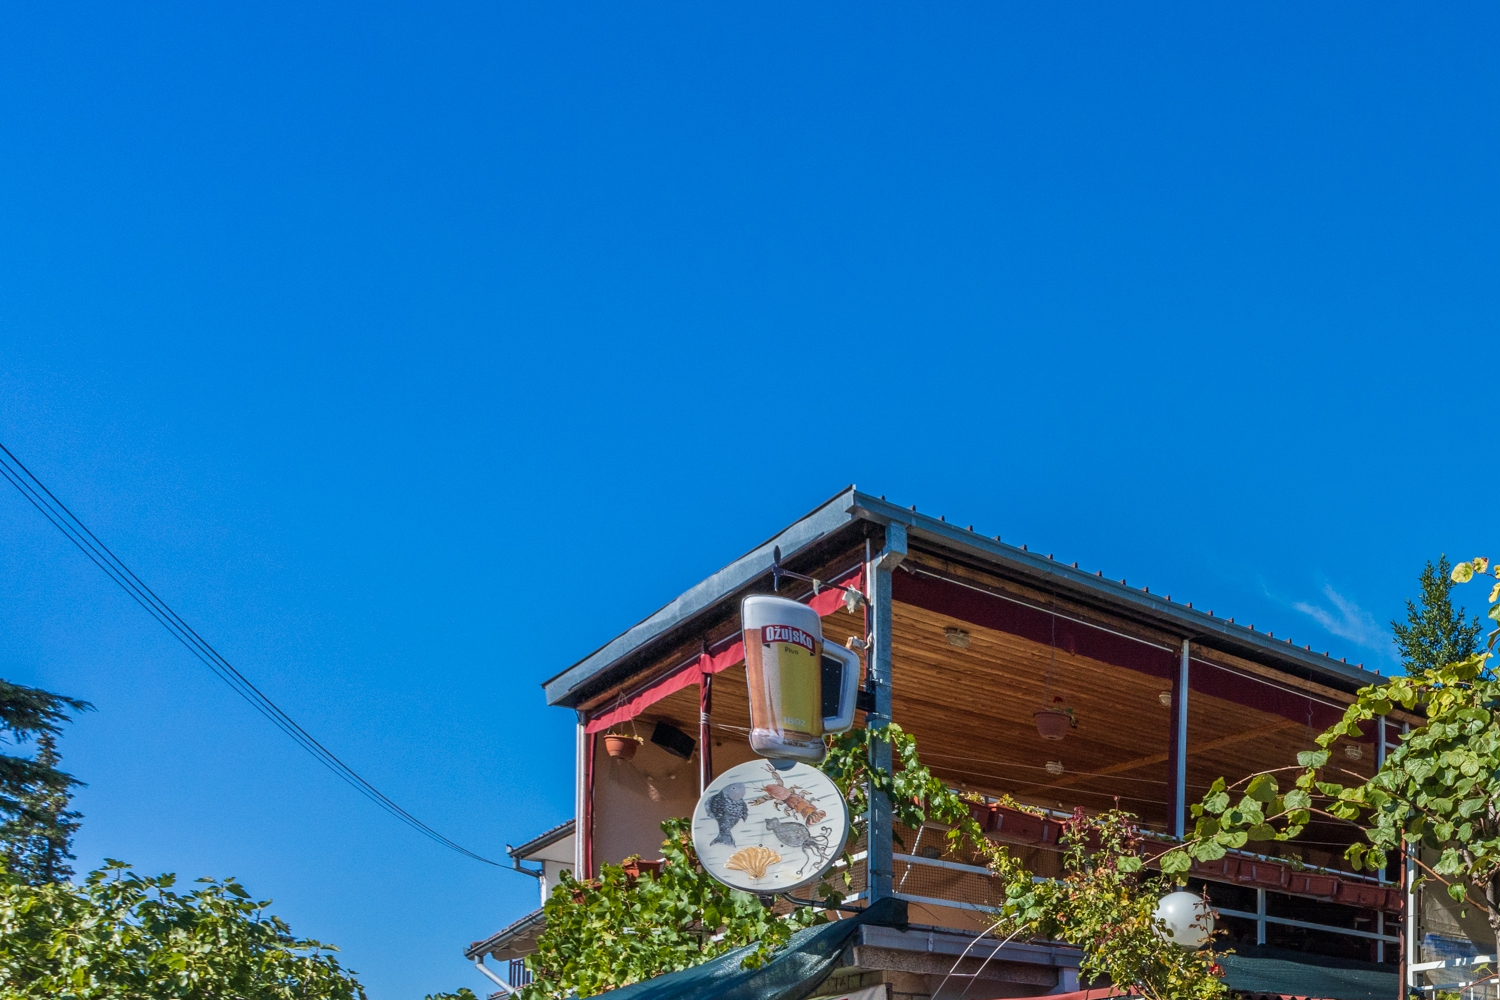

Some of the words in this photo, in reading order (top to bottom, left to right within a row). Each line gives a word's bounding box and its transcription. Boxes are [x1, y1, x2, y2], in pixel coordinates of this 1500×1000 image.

[766, 625, 813, 649] Ožujsko
[784, 646, 799, 655] Pivo
[783, 716, 806, 727] 1892
